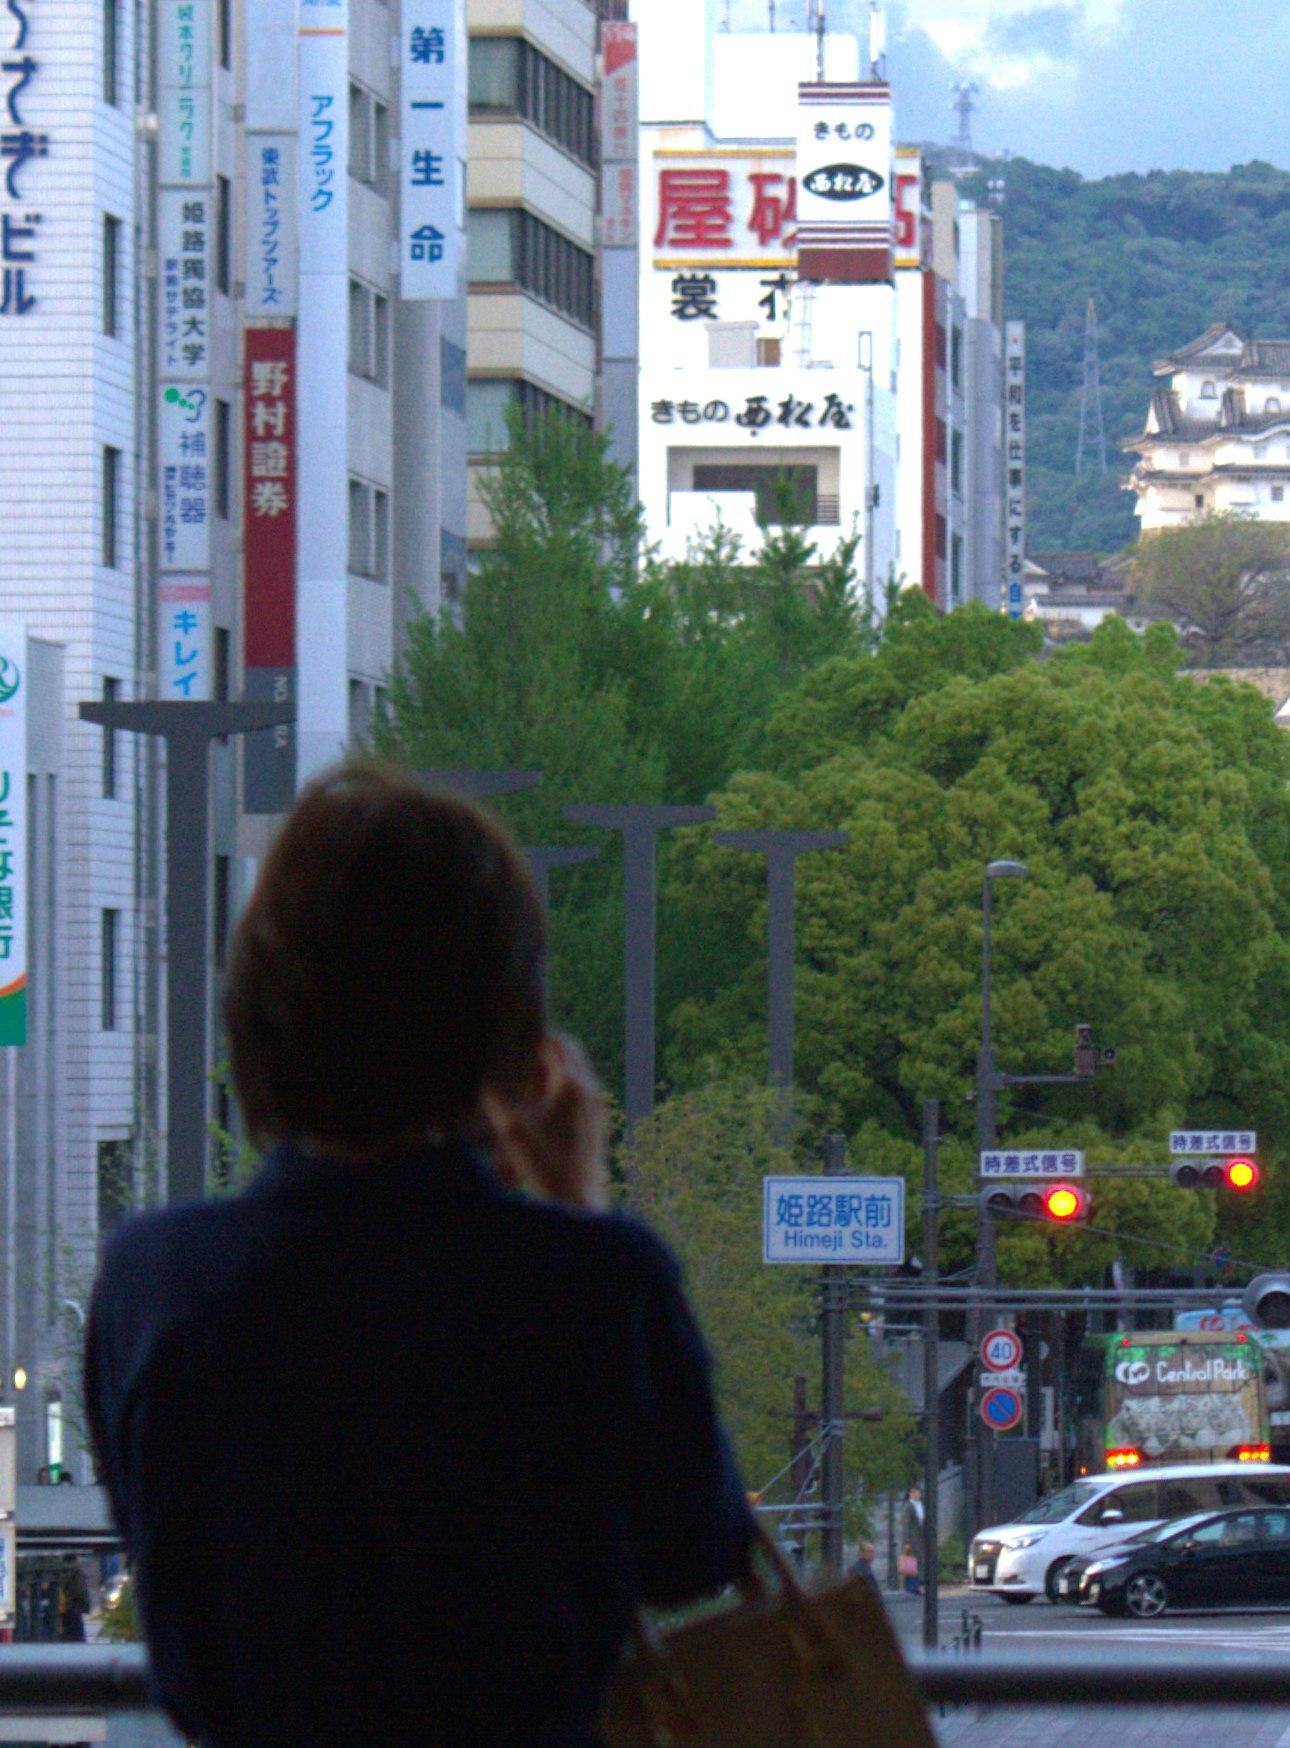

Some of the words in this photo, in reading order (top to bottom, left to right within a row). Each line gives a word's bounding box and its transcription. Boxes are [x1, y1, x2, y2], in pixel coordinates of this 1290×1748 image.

[310, 95, 334, 212] アフラック
[409, 26, 446, 263] 第一生命
[813, 120, 875, 141] きもの
[261, 147, 283, 304] 東武トップツアーズ
[182, 201, 206, 367] 姫路獨協大学
[251, 361, 289, 518] 野村證券
[1008, 356, 1022, 573] 平和を仕事にする
[179, 430, 207, 524] 補聴器
[984, 1154, 1078, 1174] 時差式信号
[1172, 1134, 1253, 1150] 時差式信号
[776, 1193, 892, 1228] 姫路駅前
[784, 1230, 843, 1251] Himeji
[851, 1230, 888, 1249] Sta.
[991, 1342, 1012, 1360] 40
[1156, 1360, 1212, 1383] Central
[1213, 1357, 1248, 1381] Park
